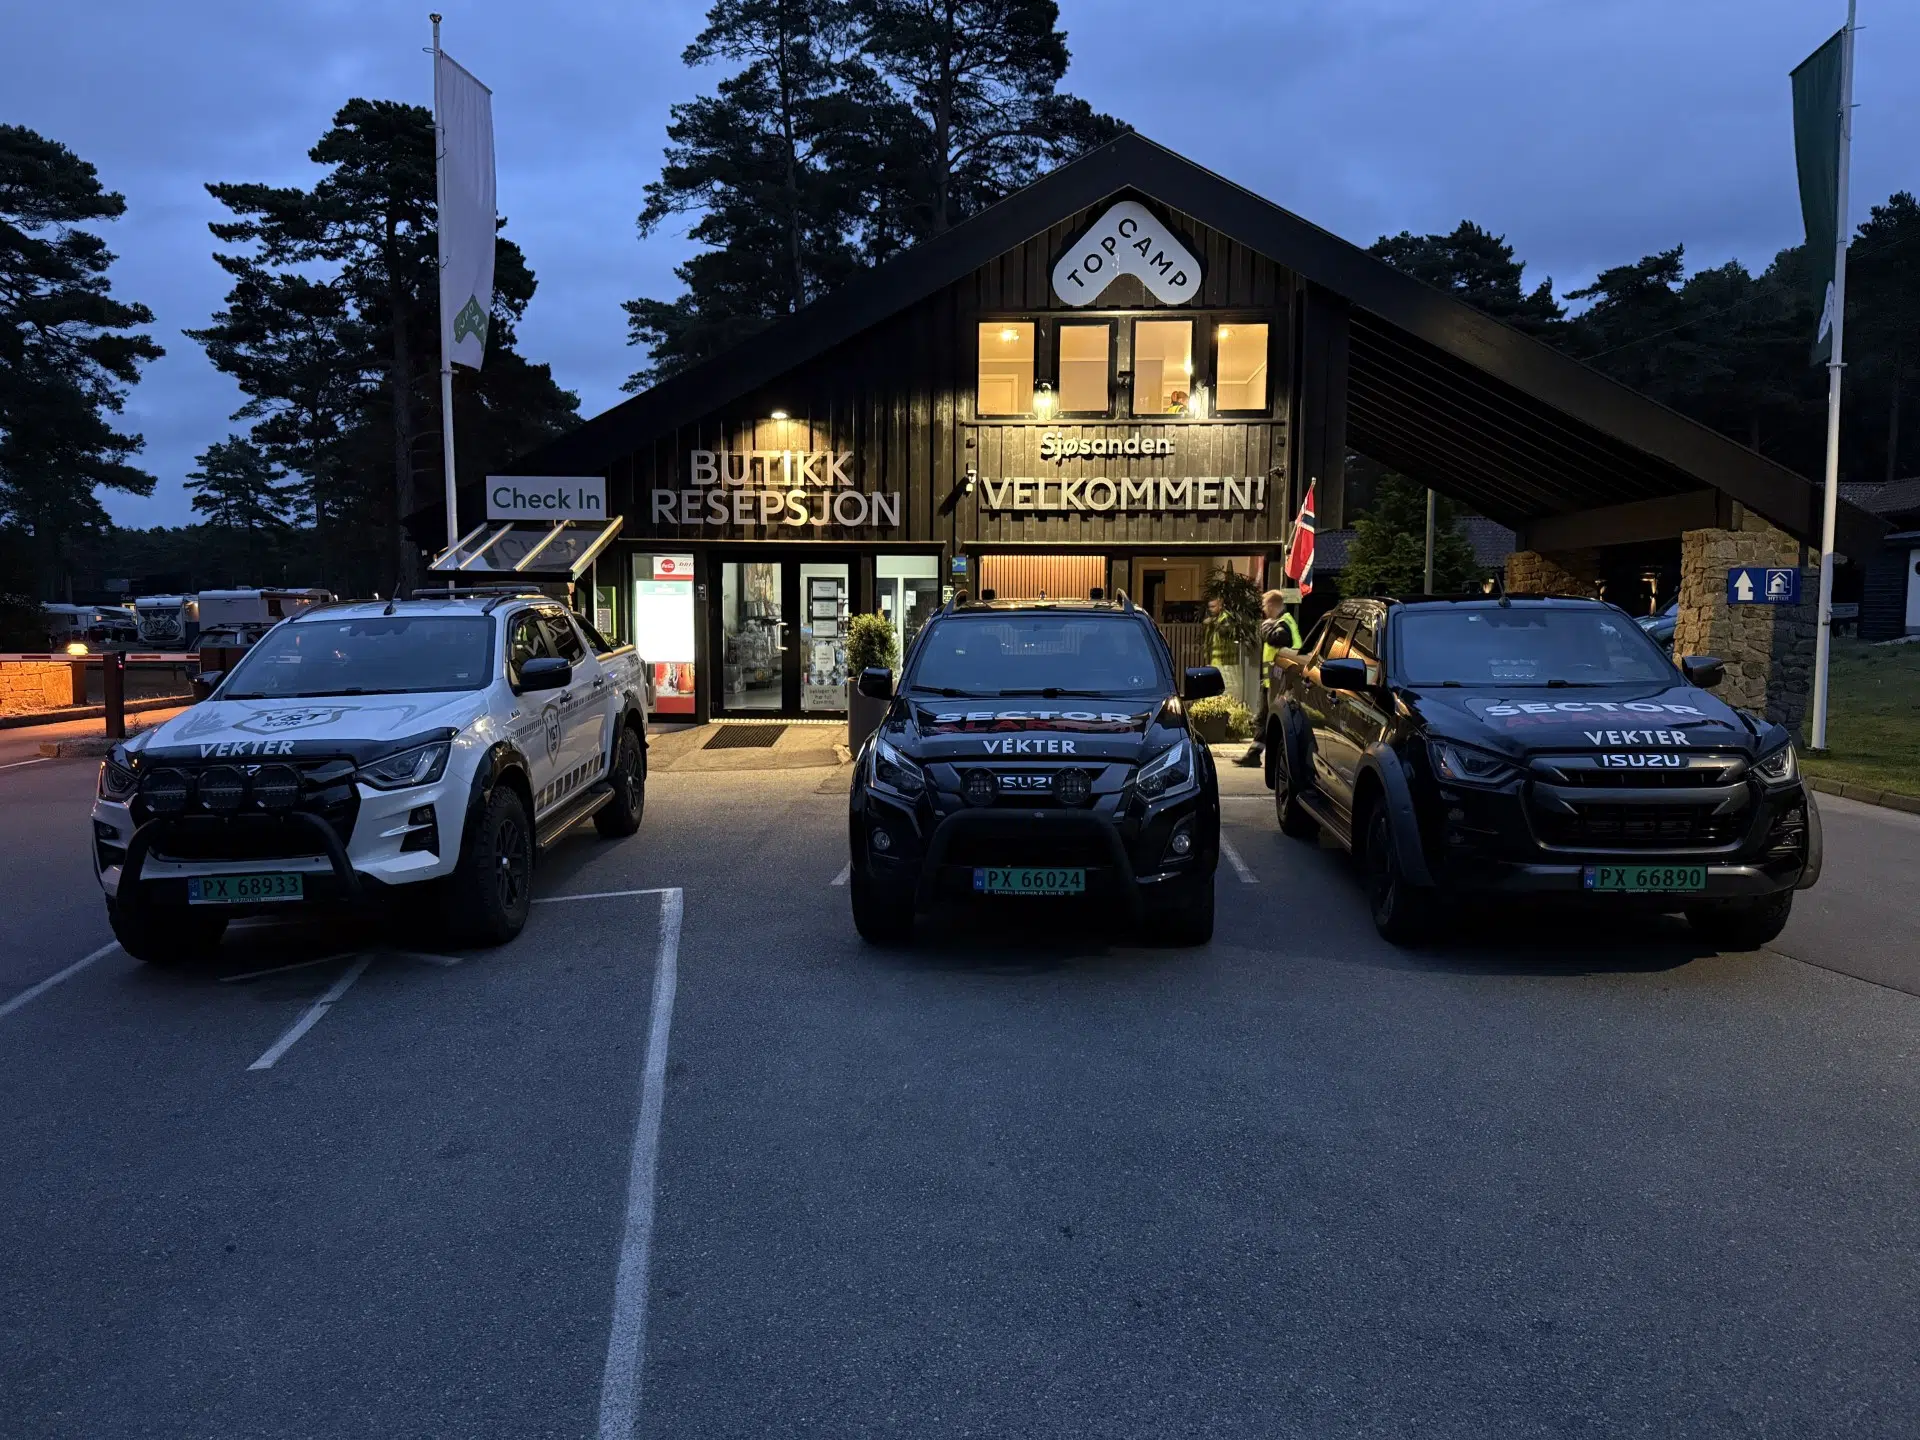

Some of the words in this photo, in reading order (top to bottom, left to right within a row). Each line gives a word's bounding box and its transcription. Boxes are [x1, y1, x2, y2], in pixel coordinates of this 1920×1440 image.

[1067, 218, 1188, 289] TOPCAMP
[1041, 432, 1172, 462] Sjøsanden
[690, 449, 855, 487] BUTIKK
[492, 485, 571, 511] Check
[577, 486, 601, 511] In
[982, 476, 1266, 512] VELKOMMEN!
[650, 488, 902, 527] RESEPSJON
[935, 711, 1132, 723] SECTOR
[1485, 702, 1707, 716] SECTOR
[982, 739, 1077, 754] VEKTER
[1584, 730, 1691, 746] VEKTER
[200, 740, 295, 759] VEKTER
[1602, 754, 1680, 767] ISUZU
[997, 776, 1053, 789] ISUZ
[203, 879, 228, 897] PX
[238, 876, 299, 896] 68933
[988, 870, 1012, 887] PX
[1021, 870, 1081, 888] 66024
[1600, 868, 1626, 886] PX
[1636, 868, 1701, 887] 66890
